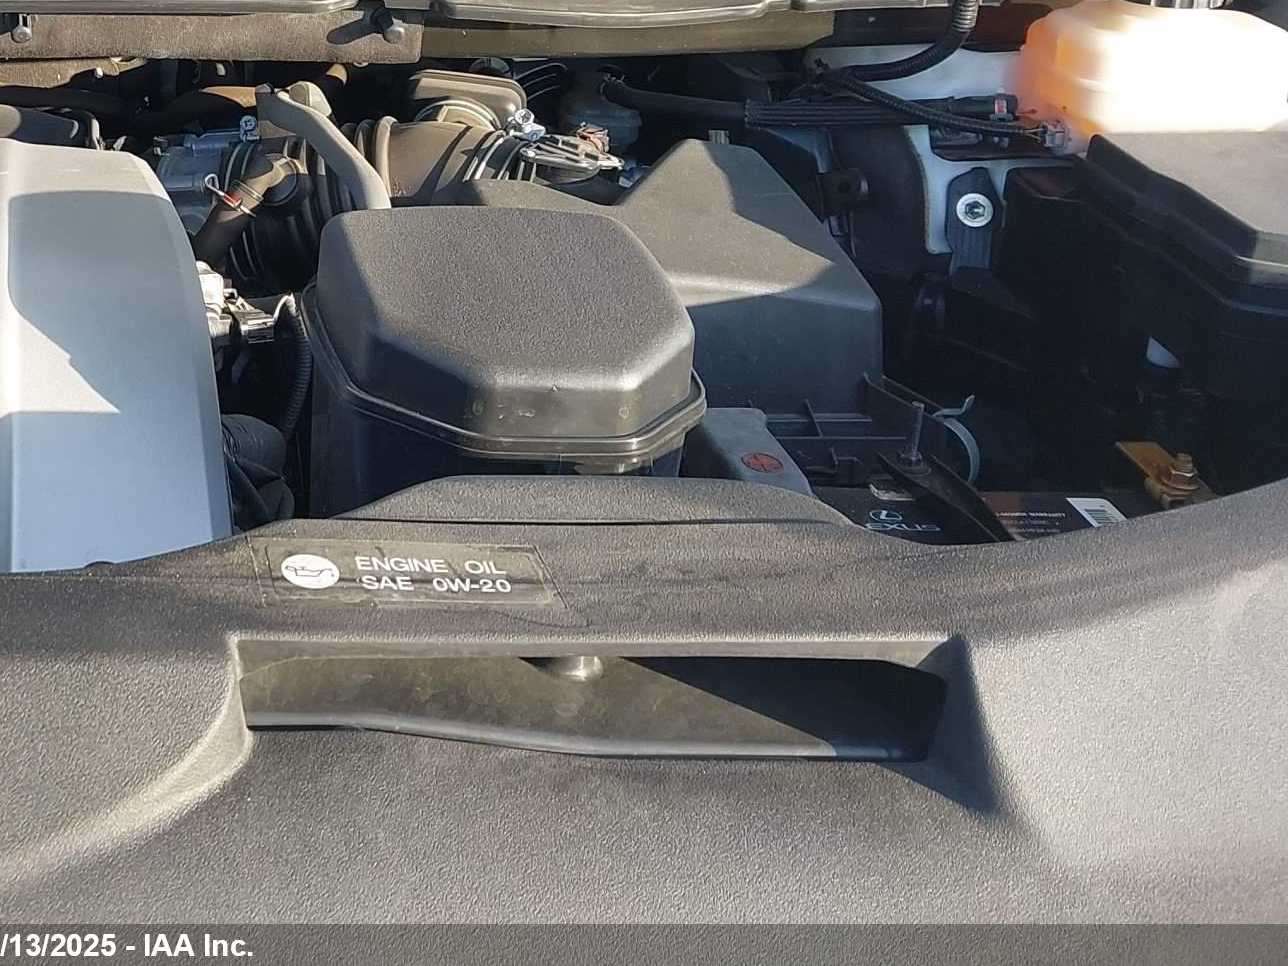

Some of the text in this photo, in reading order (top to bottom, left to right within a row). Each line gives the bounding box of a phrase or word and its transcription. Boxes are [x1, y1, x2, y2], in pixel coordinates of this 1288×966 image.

[865, 522, 941, 532] EXUS
[355, 556, 507, 575] ENGINE OIL
[361, 575, 512, 593] SAE 0W-20
